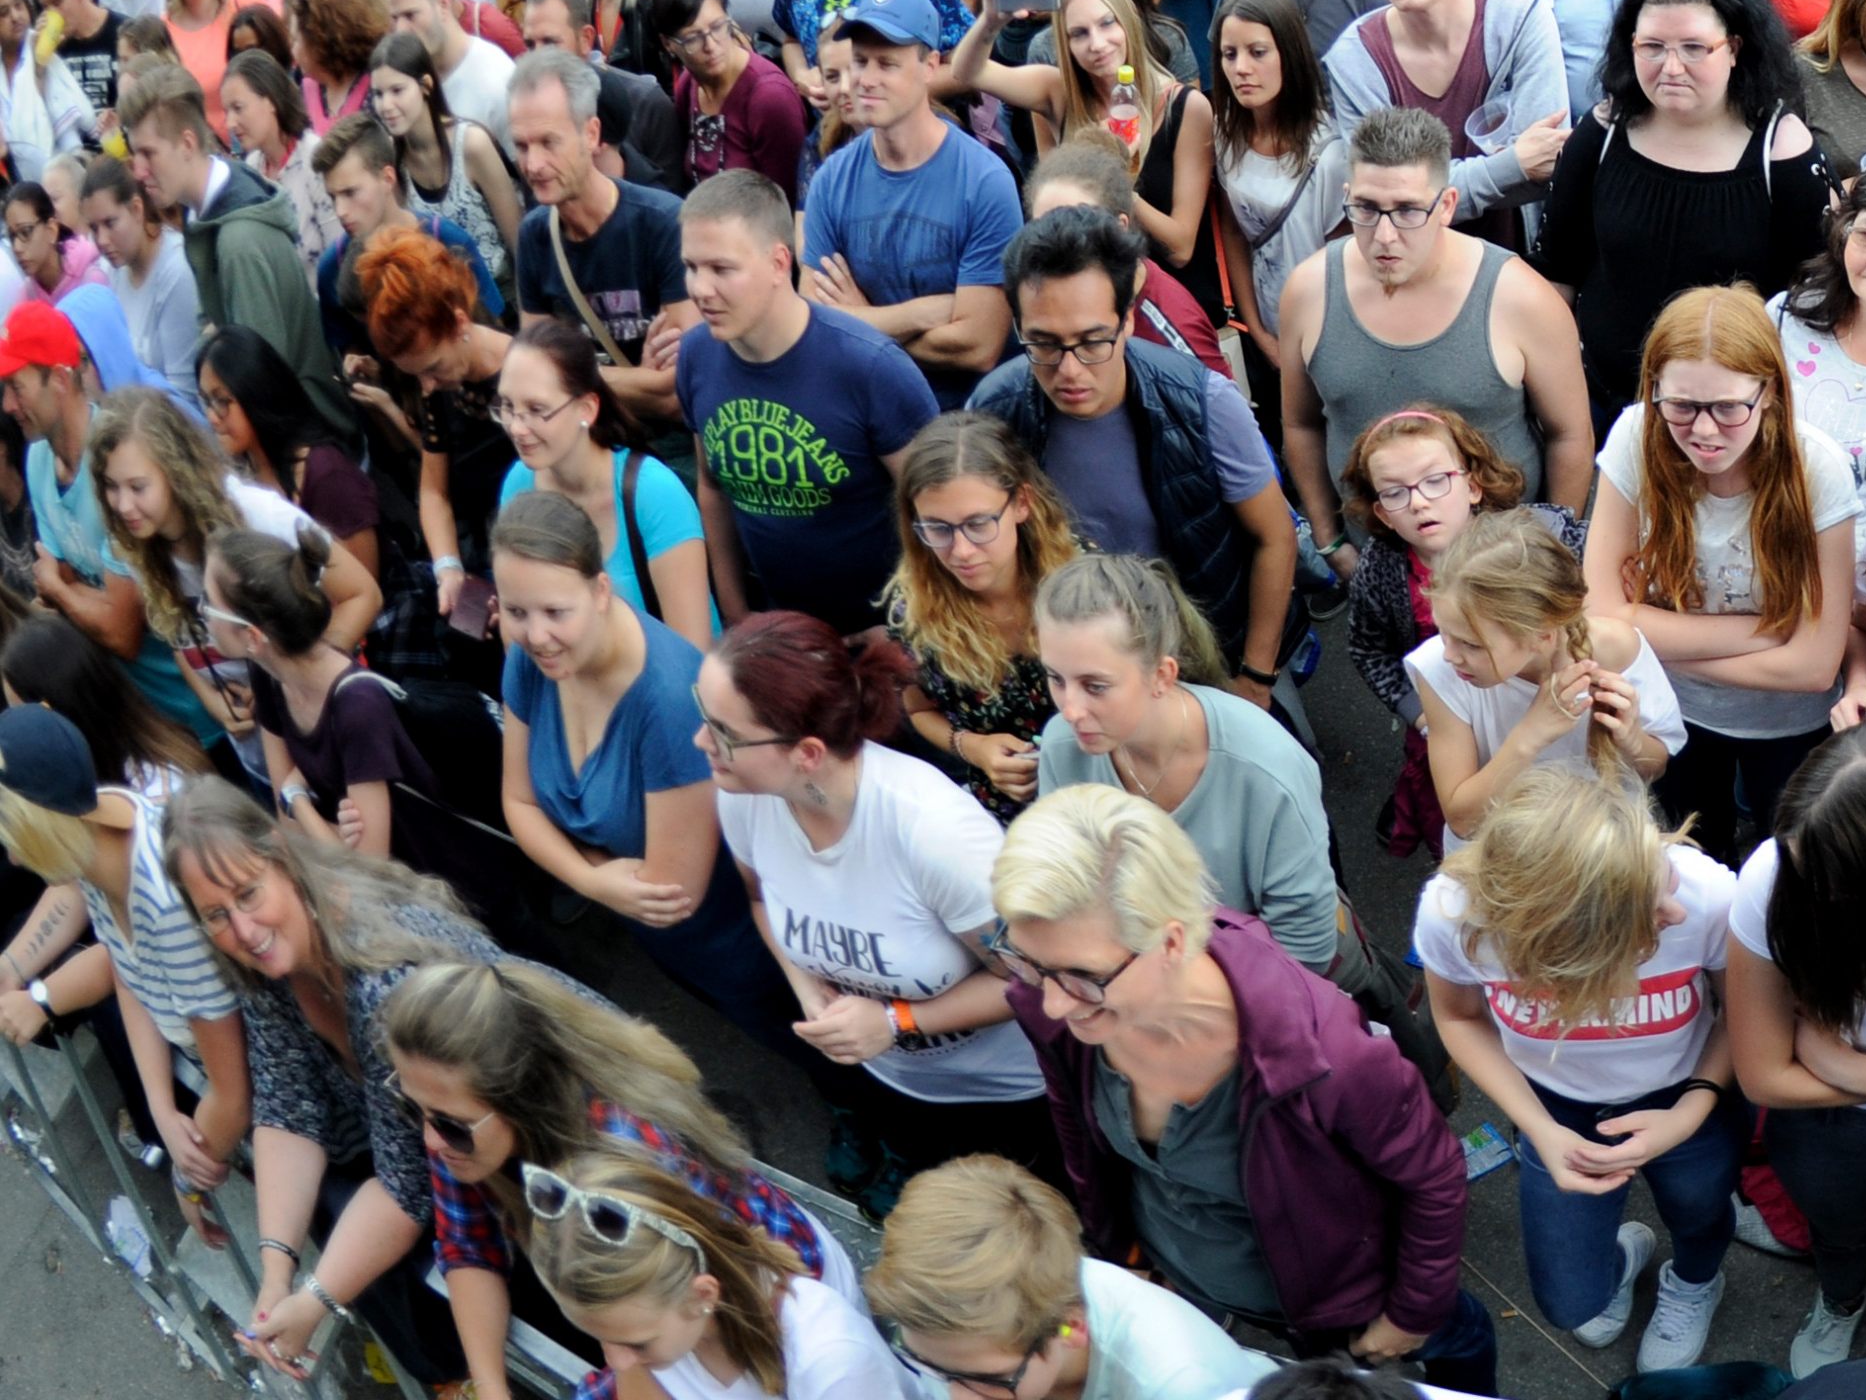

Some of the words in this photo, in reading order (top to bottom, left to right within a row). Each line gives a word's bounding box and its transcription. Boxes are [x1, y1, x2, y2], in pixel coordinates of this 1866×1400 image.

[715, 424, 815, 488] 1981
[738, 399, 791, 431] BLUE
[786, 414, 850, 484] JEANS
[768, 484, 832, 508] GOODS
[785, 907, 902, 978] MAYBE
